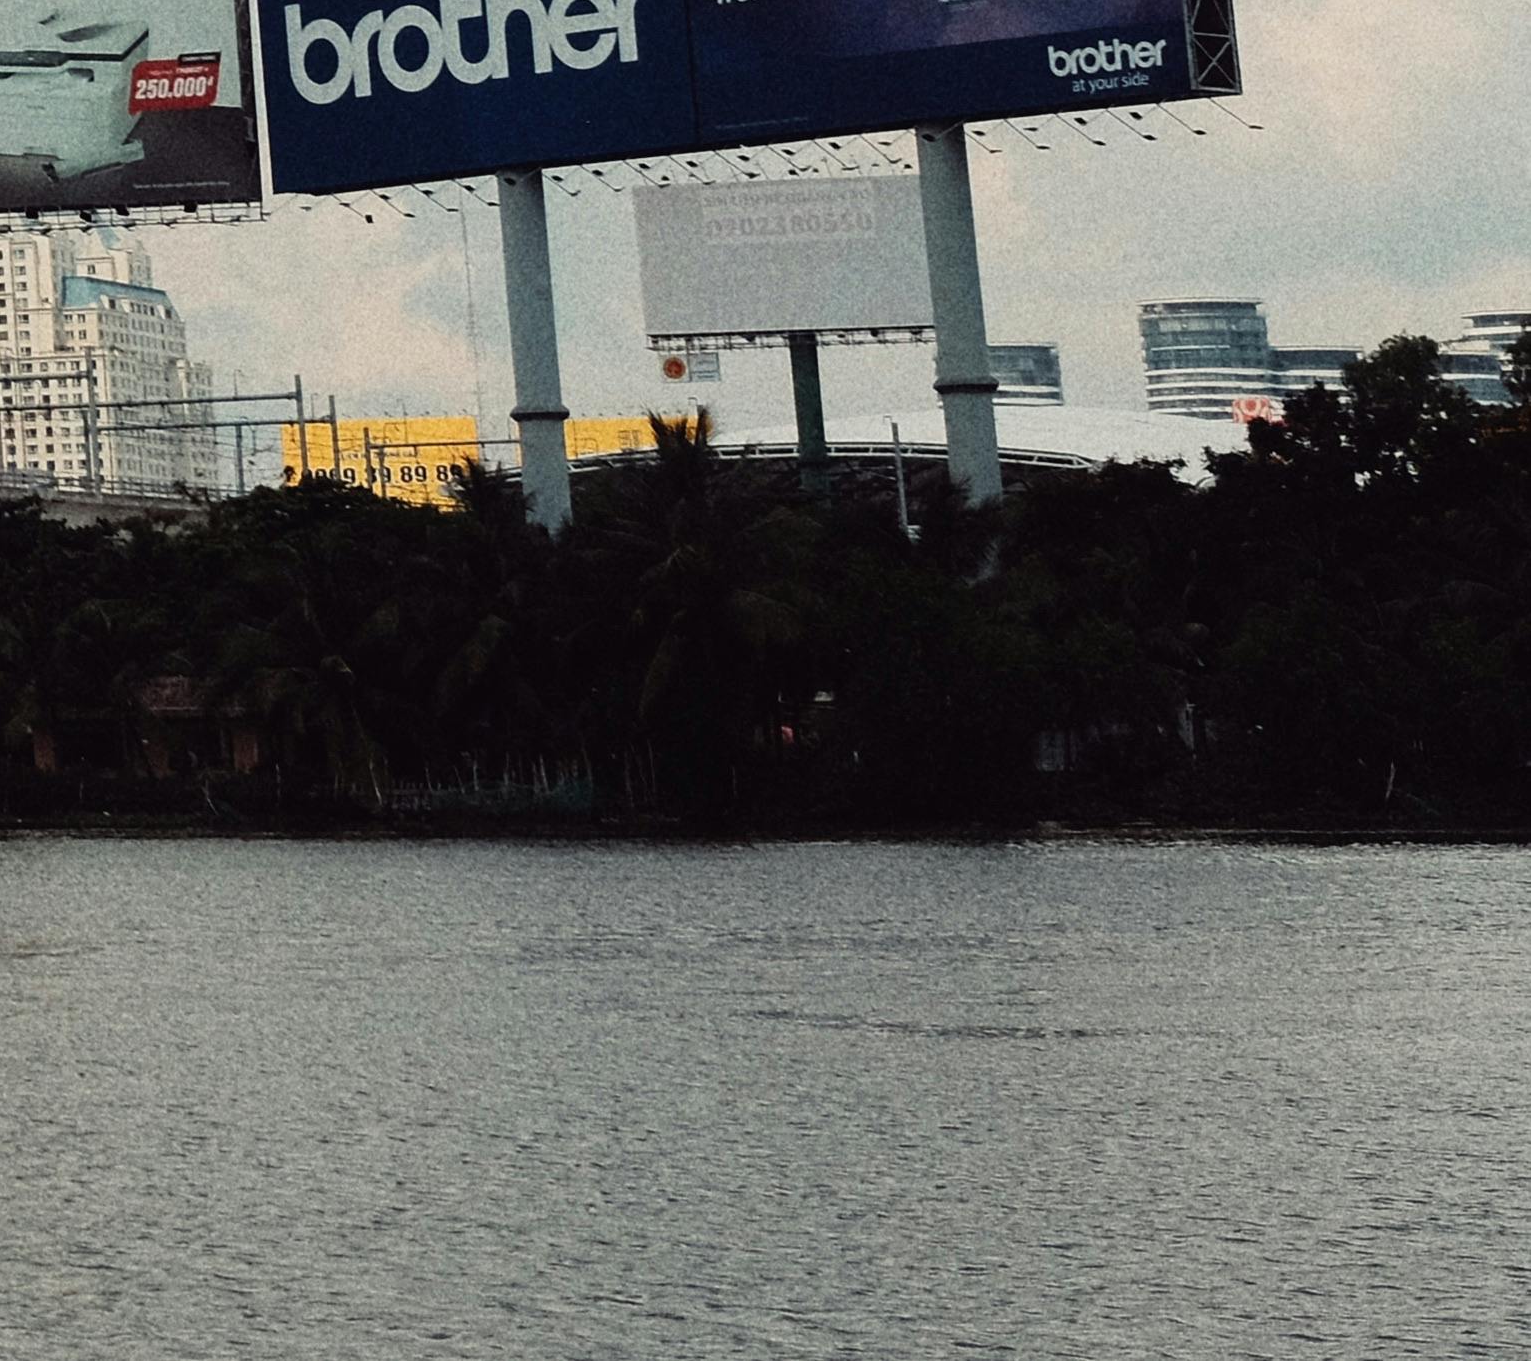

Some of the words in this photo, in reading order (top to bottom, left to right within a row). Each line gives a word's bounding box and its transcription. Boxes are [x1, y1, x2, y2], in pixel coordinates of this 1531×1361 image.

[1047, 39, 1167, 77] brother
[1072, 79, 1086, 93] at
[1089, 77, 1120, 95] your
[1121, 72, 1150, 88] side
[400, 464, 427, 483] 89
